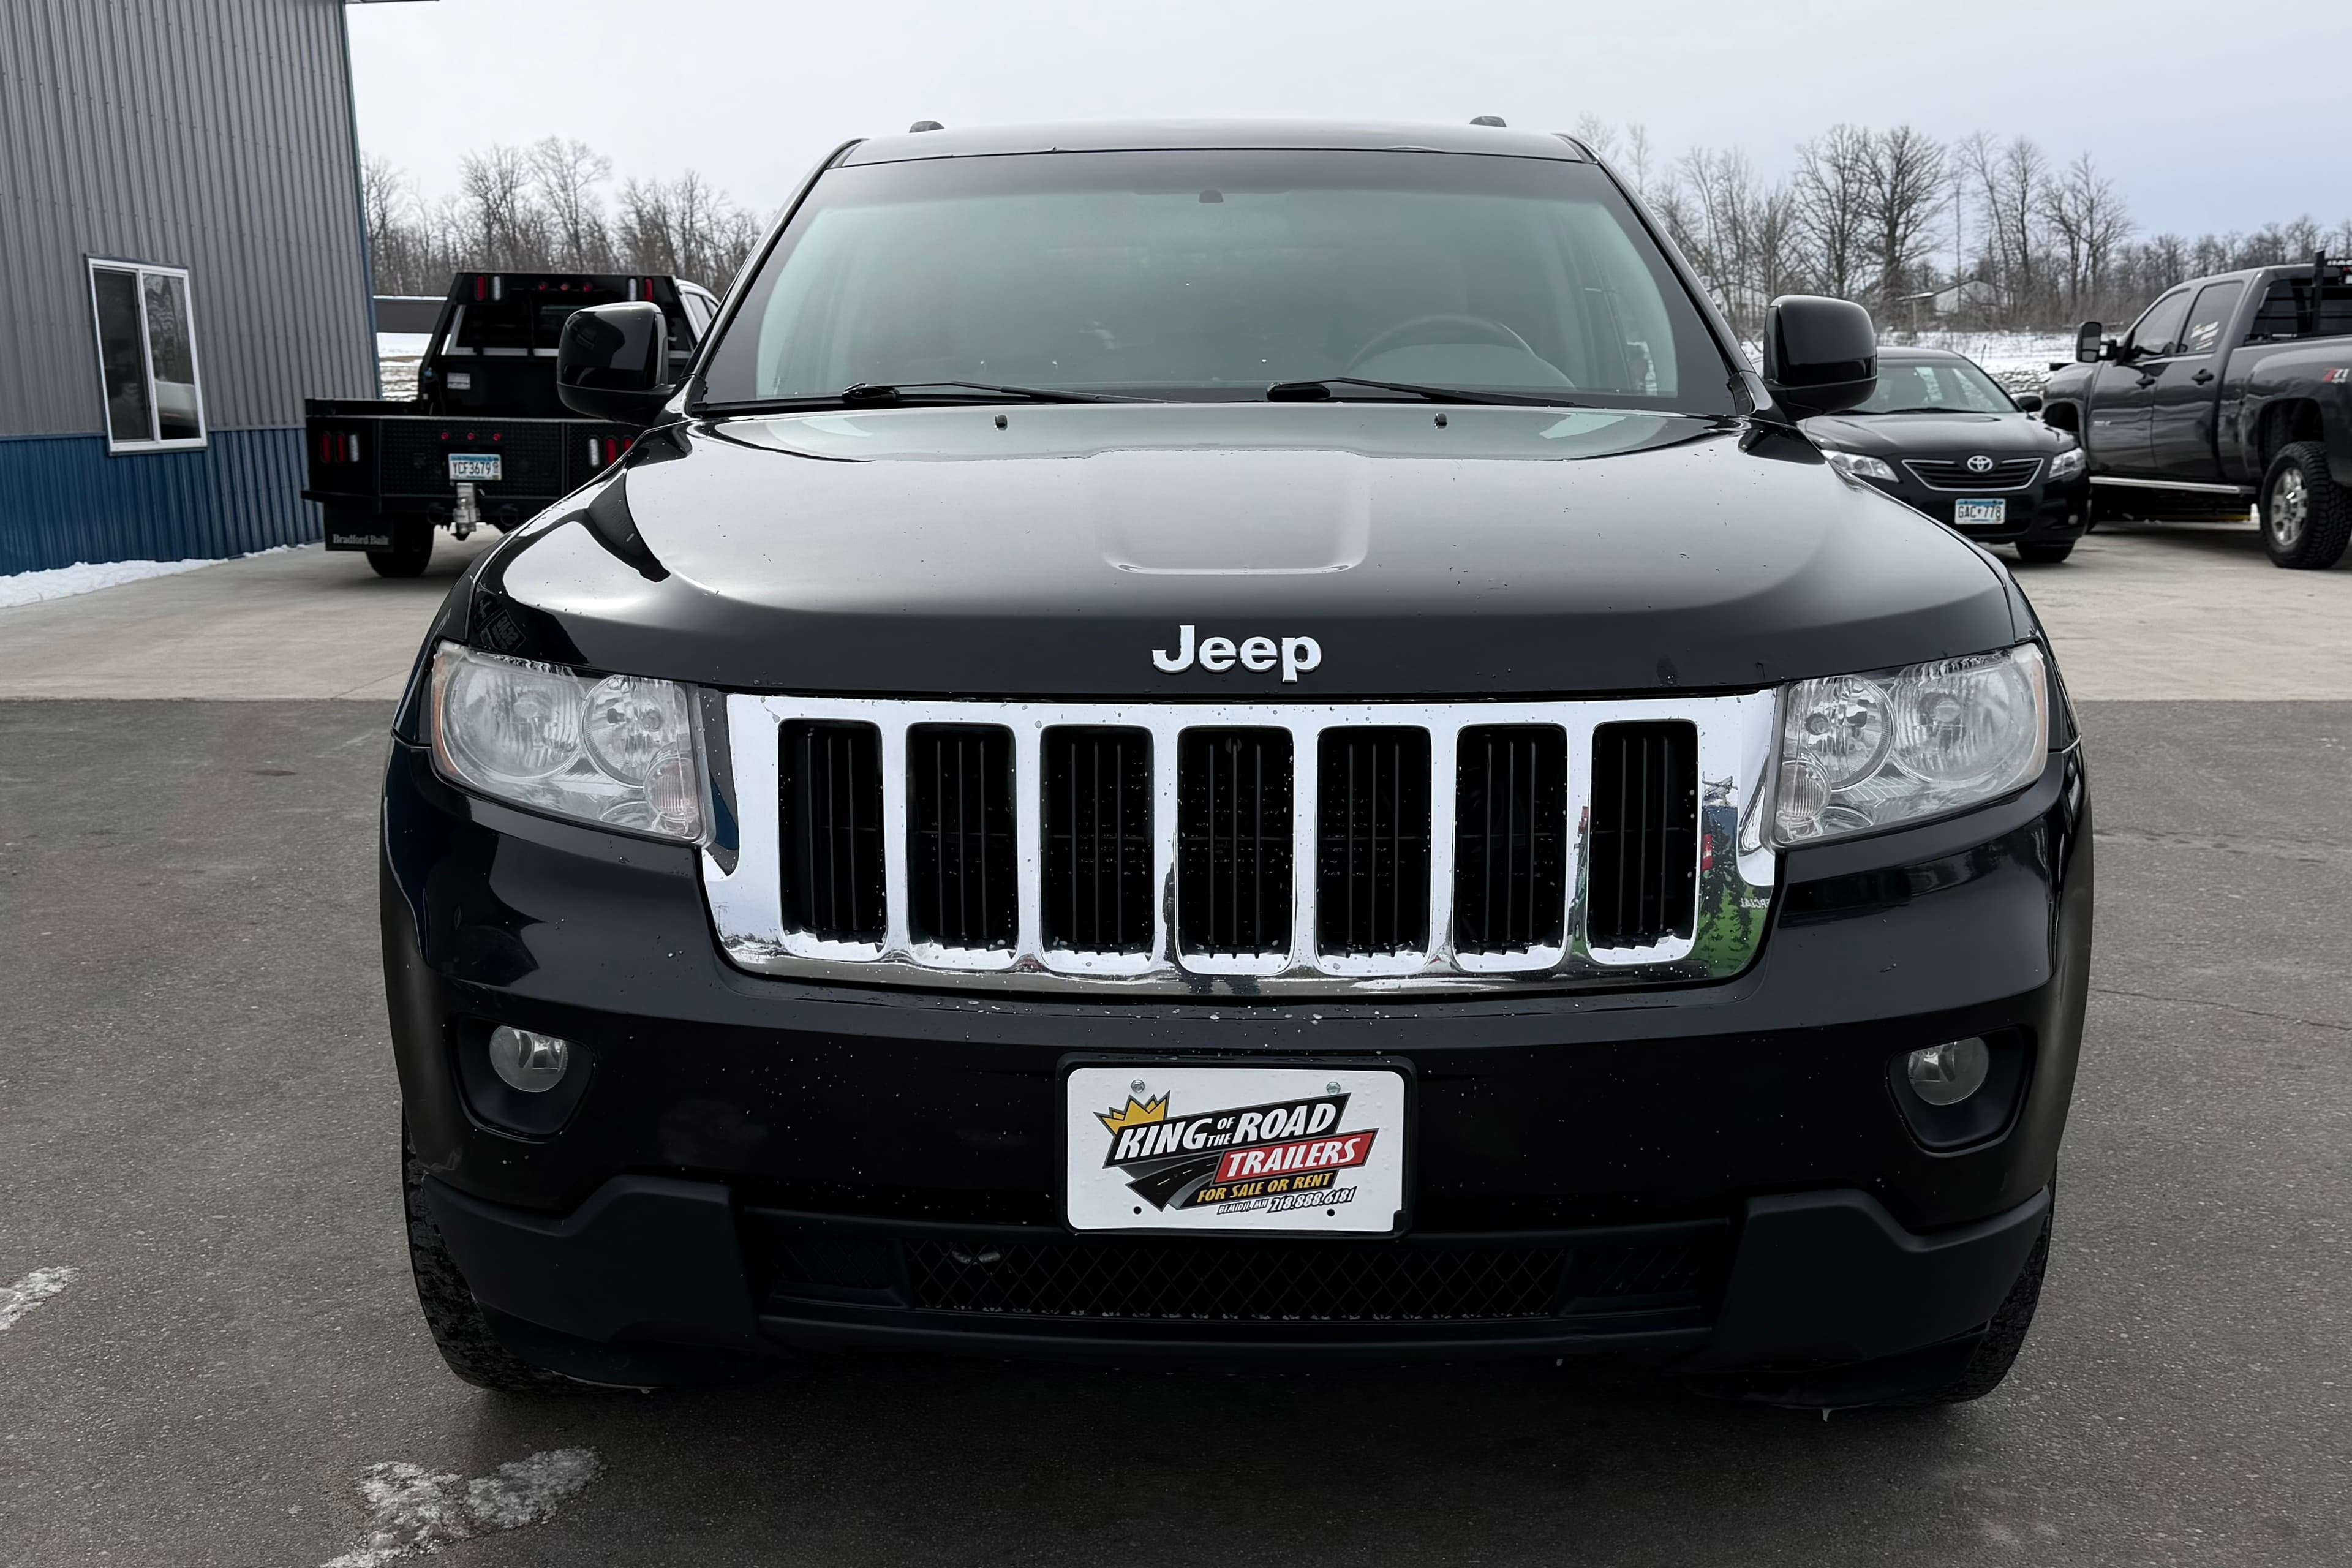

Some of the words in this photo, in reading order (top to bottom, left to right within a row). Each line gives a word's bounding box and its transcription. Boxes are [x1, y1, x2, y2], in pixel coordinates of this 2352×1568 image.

[453, 462, 491, 475] YCF3679
[333, 534, 369, 545] Bradford
[1152, 625, 1322, 683] Jeep
[1217, 1117, 1235, 1130] OF
[1232, 1103, 1336, 1144] ROAD
[1114, 1118, 1213, 1161] KING
[1207, 1133, 1232, 1147] THE
[1227, 1138, 1361, 1178] TRAILERS
[1197, 1187, 1227, 1203] FOR
[1230, 1182, 1265, 1199] SALE
[1267, 1178, 1289, 1193] OR
[1292, 1172, 1333, 1189] RENT
[1269, 1189, 1355, 1212] 218.888.6181
